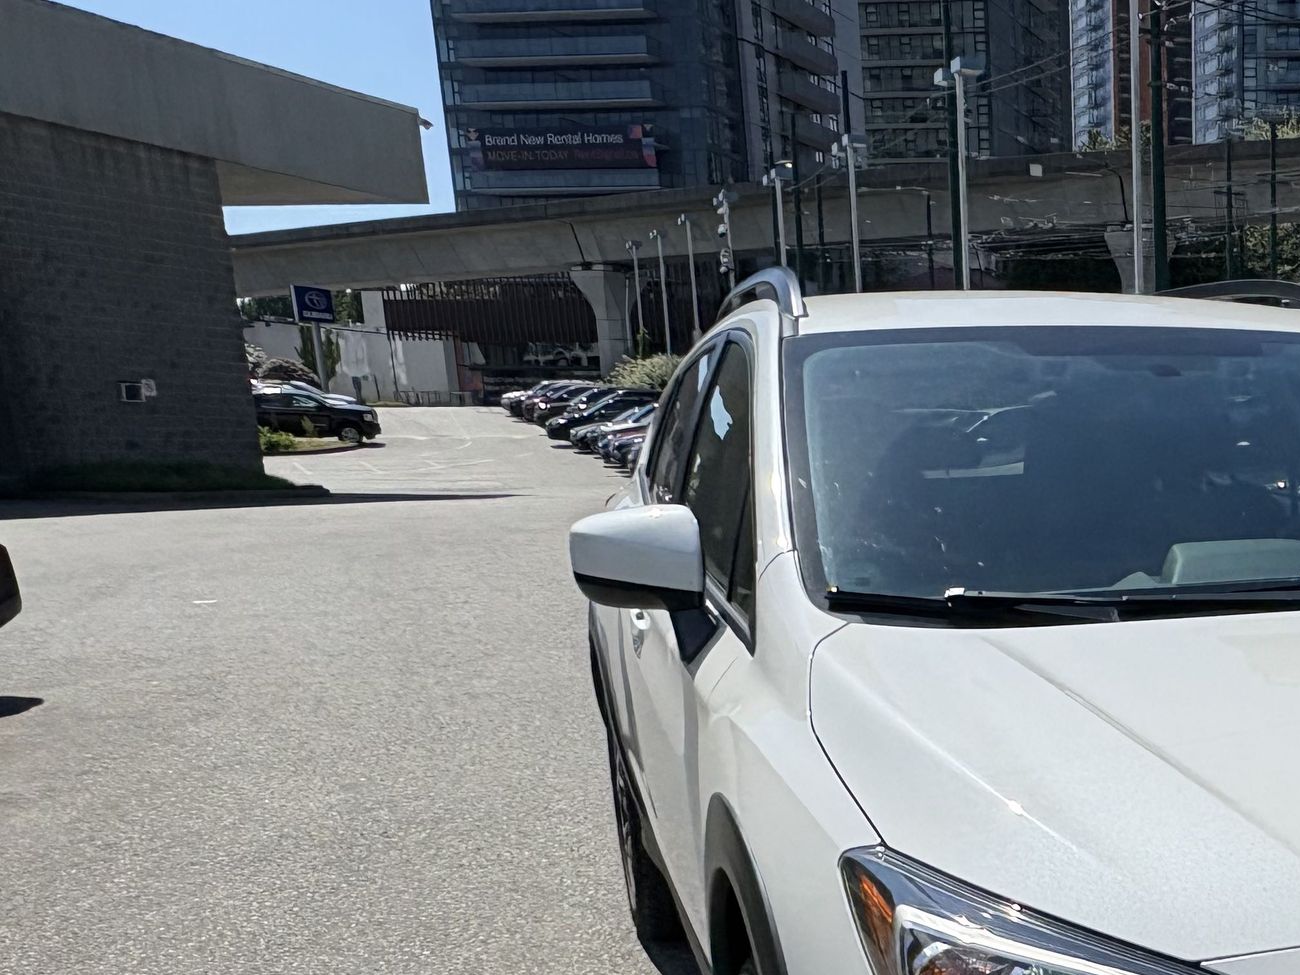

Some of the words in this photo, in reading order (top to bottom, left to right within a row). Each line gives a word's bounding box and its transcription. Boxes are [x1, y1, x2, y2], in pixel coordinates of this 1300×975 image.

[485, 133, 518, 146] Brand
[520, 133, 544, 145] New
[546, 132, 581, 145] Rental
[584, 132, 624, 144] Homes
